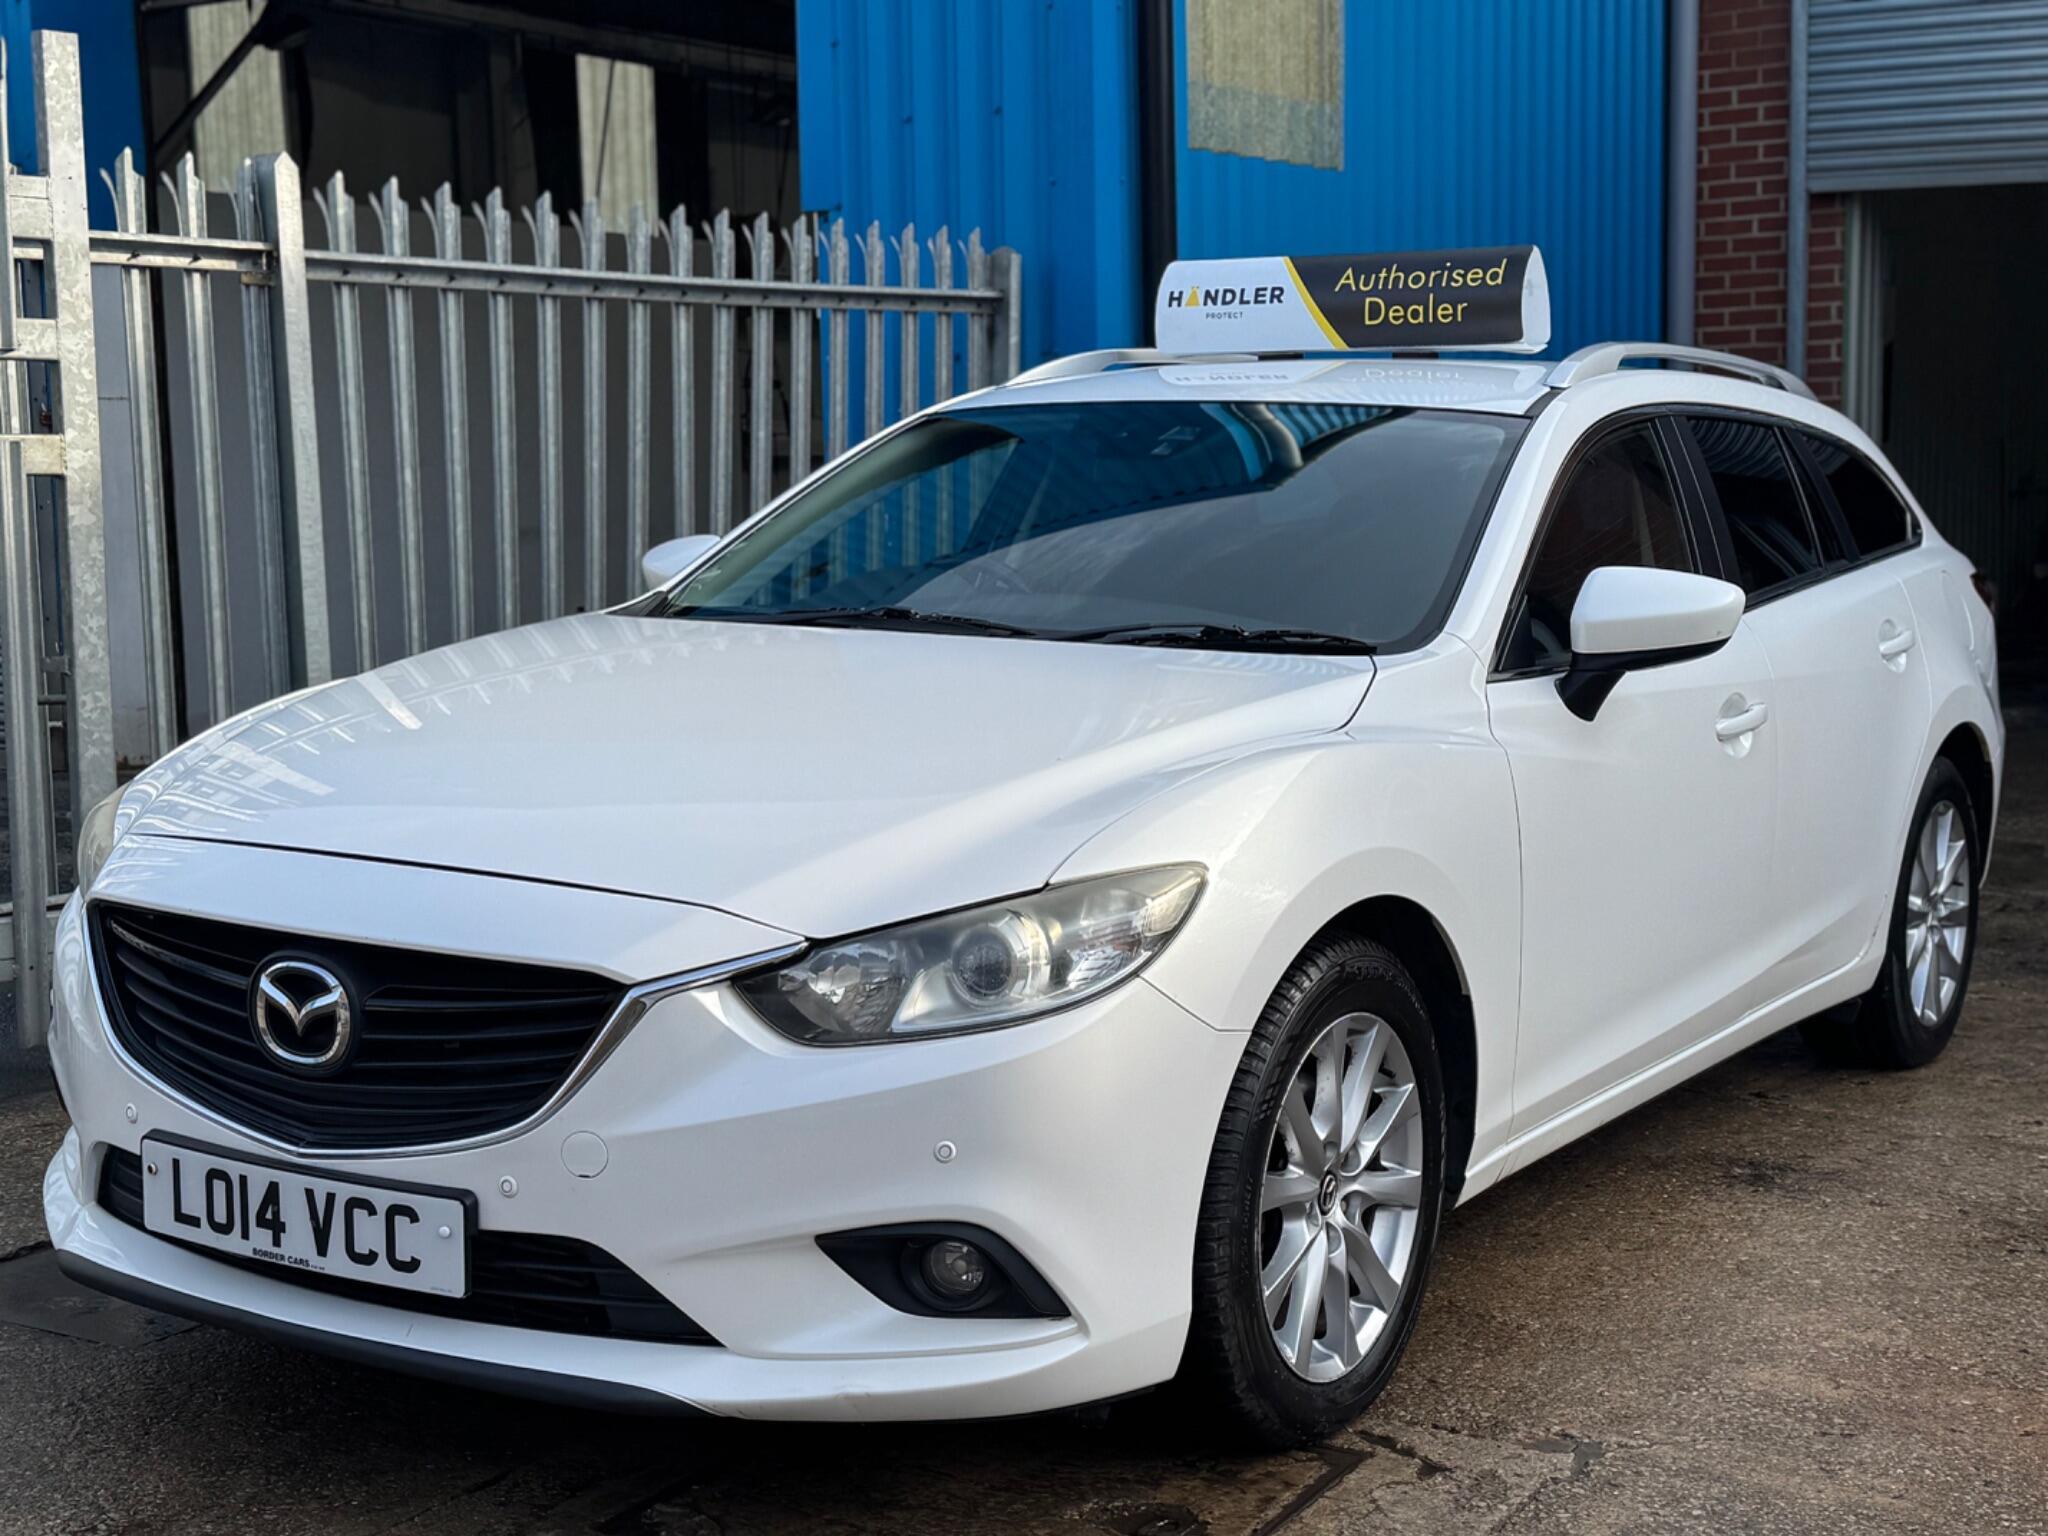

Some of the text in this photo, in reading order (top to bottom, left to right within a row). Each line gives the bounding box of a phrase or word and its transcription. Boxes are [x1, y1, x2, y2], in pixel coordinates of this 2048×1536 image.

[1334, 258, 1508, 292] Authorised
[1205, 312, 1244, 320] PROTECT
[1364, 295, 1468, 326] Dealer
[172, 1158, 422, 1274] LO14 VCC
[252, 1247, 286, 1262] BORDER
